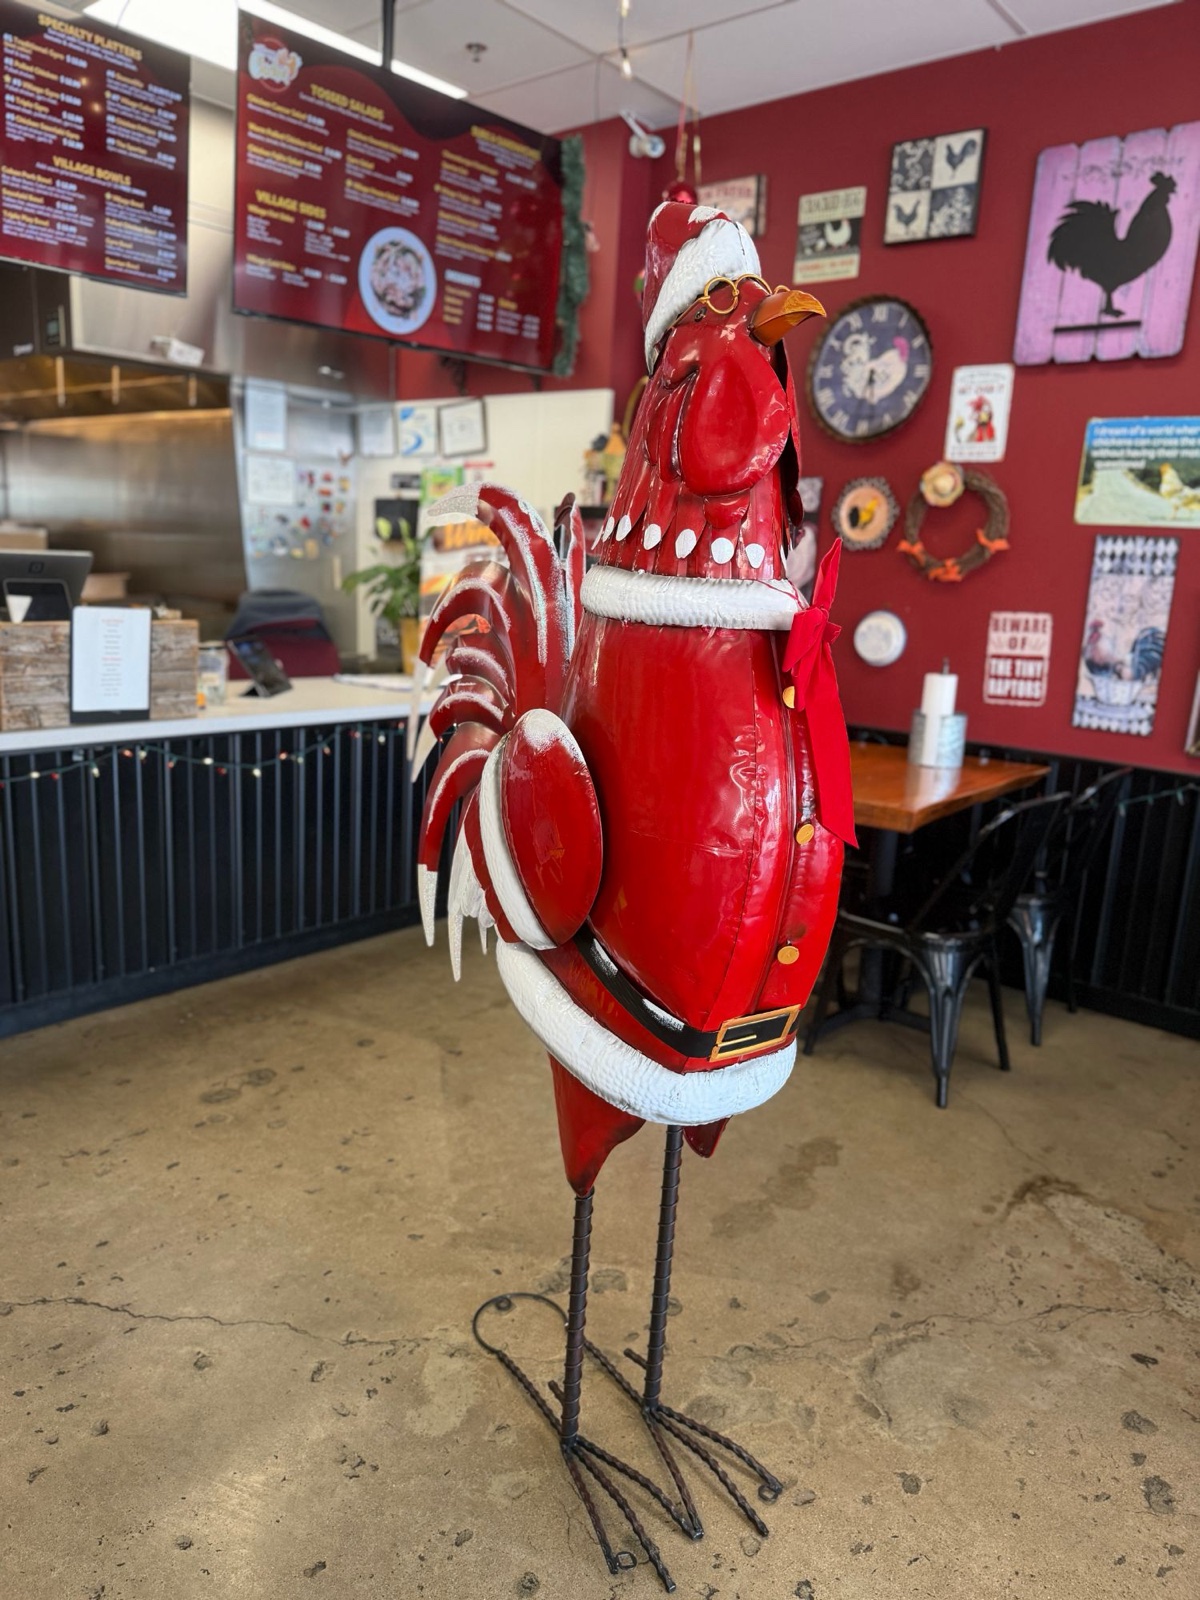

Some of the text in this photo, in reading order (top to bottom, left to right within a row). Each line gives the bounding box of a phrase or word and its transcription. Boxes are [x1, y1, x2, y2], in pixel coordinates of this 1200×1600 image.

[37, 13, 94, 44] SPECIALTY
[93, 32, 143, 62] PLATTERS
[309, 82, 349, 108] TOSSED
[348, 97, 385, 122] SALADS
[53, 155, 95, 178] VILLAGE
[96, 167, 131, 187] BOWLS
[255, 189, 327, 221] VILLAGE SIDES
[1091, 436, 1197, 447] chickens can cross the
[1097, 426, 1128, 436] dream
[1148, 425, 1175, 436] world
[1175, 425, 1200, 436] wher
[1090, 448, 1125, 458] without
[1126, 448, 1156, 460] having
[1156, 448, 1179, 458] their
[992, 618, 1048, 634] BEWARE
[1009, 637, 1027, 650] OF
[989, 657, 1044, 679] THE TINY
[986, 677, 1043, 700] RAPTORS
